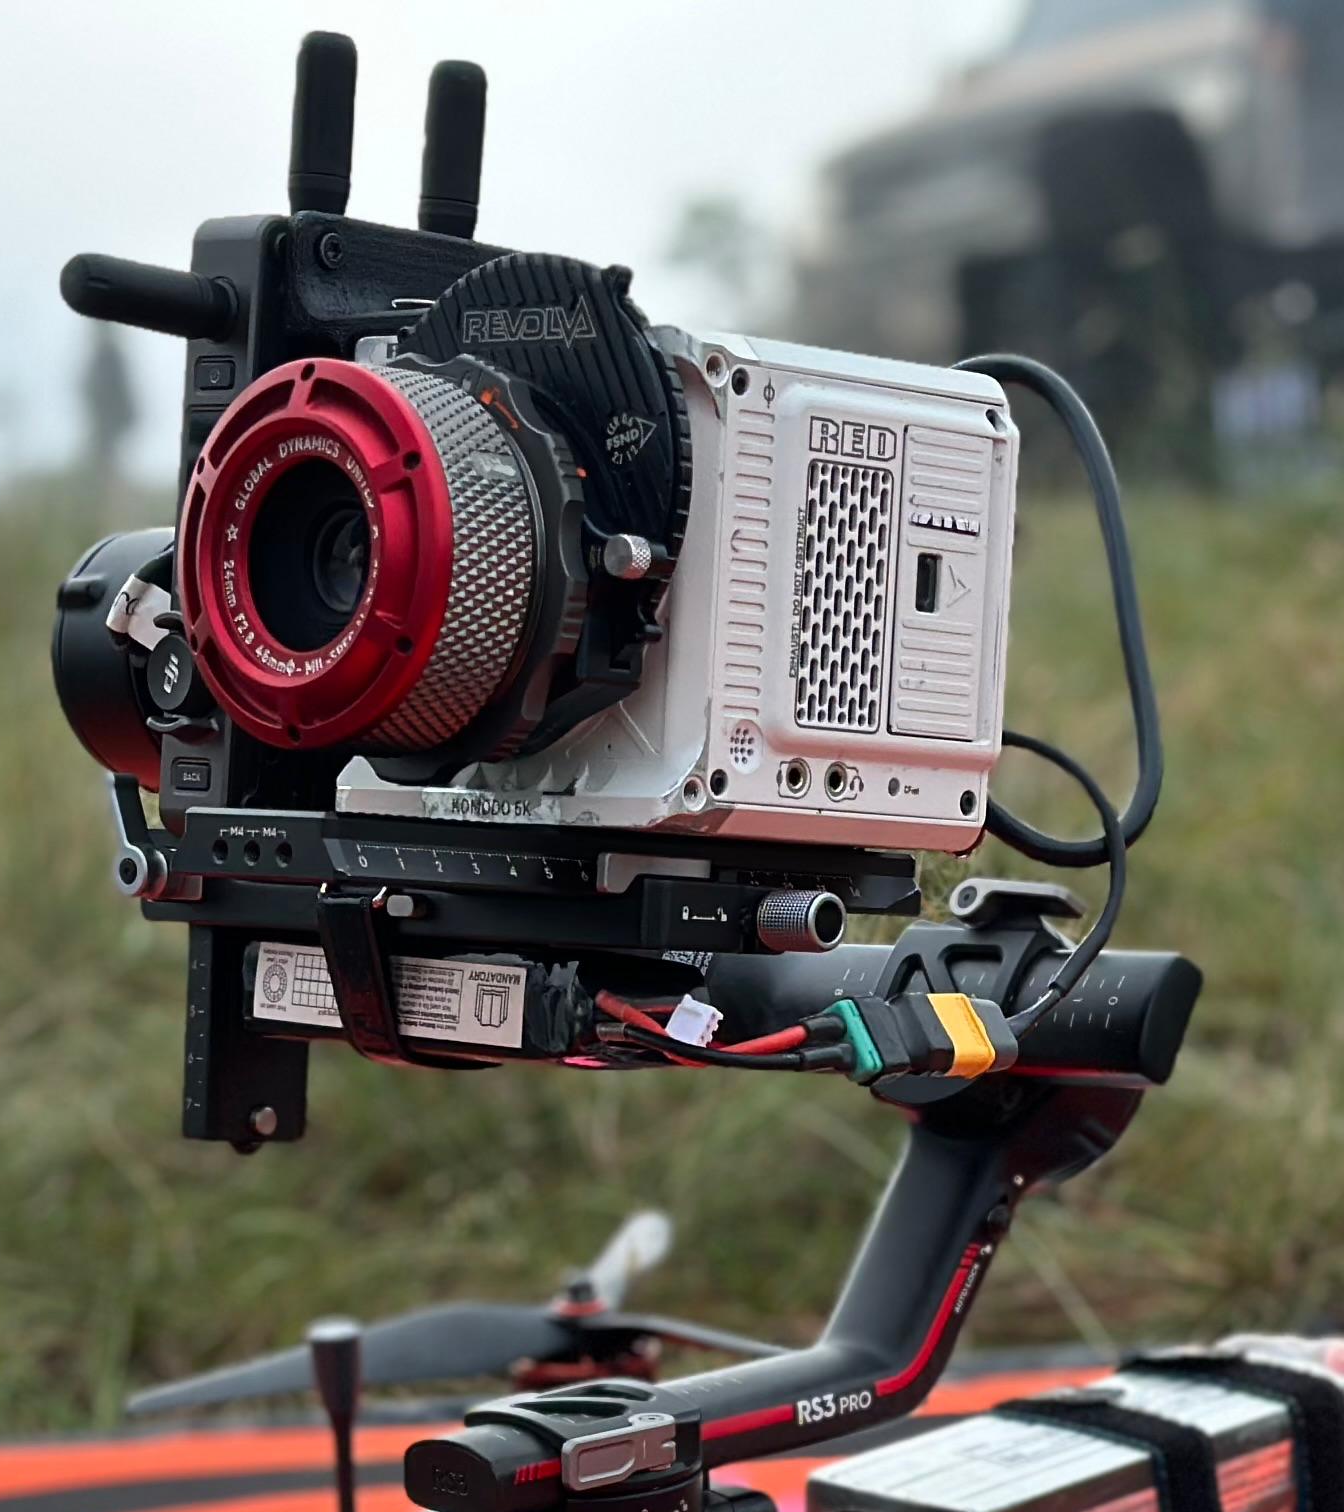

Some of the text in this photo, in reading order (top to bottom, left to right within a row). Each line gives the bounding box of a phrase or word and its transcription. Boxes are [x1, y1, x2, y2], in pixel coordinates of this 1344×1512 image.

[463, 295, 597, 349] REVOLVA
[809, 416, 897, 462] RED
[235, 457, 273, 511] GLOBAL
[278, 436, 341, 459] DYNAMICS
[514, 799, 532, 817] 6K
[230, 825, 277, 838] M4 M4
[435, 860, 444, 873] 2
[472, 862, 481, 875] 3
[797, 1390, 872, 1426] RS3 PRO
